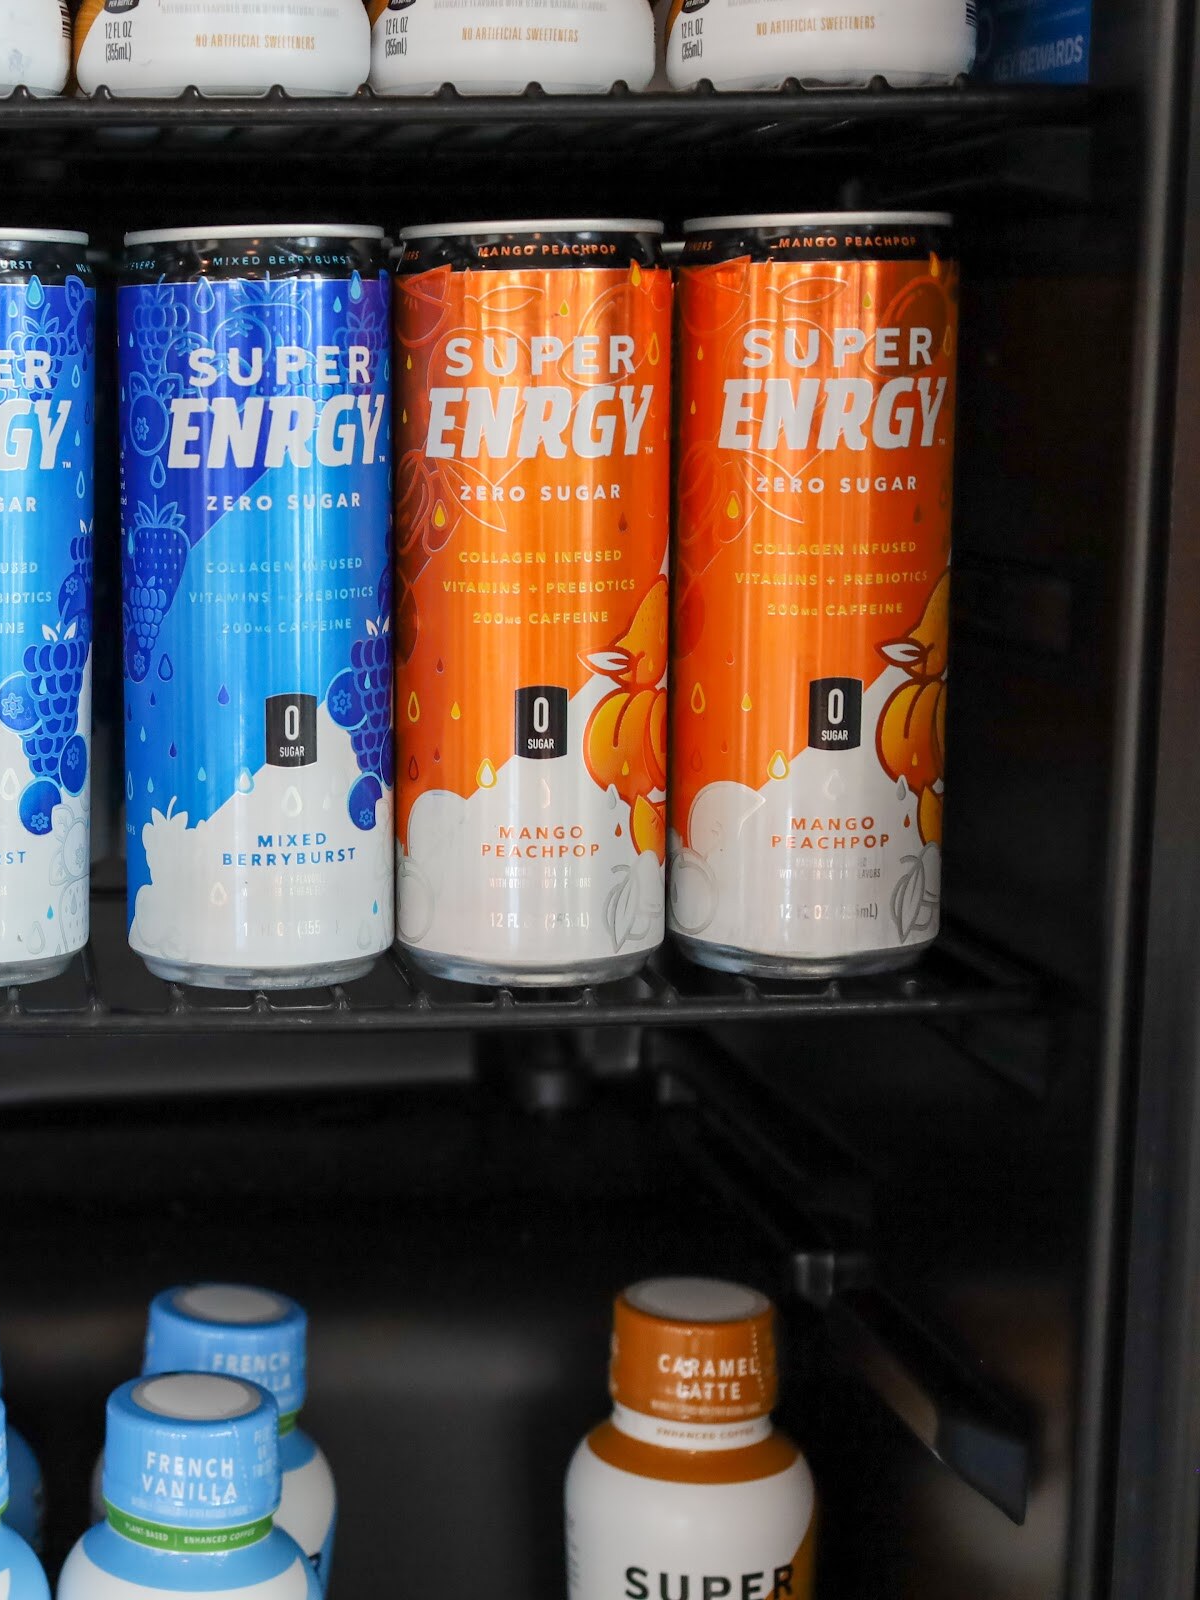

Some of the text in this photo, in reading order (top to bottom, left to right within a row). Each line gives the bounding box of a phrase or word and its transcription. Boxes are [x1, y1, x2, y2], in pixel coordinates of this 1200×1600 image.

[105, 20, 132, 39] 12 FL OZ
[386, 16, 408, 36] 12 FL OZ
[462, 27, 579, 43] NO ARTIFICIAL SWEETENERS
[681, 17, 703, 39] 12 FL OZ
[757, 16, 875, 36] NO ARTIFICIAL SWEETENERS
[195, 34, 315, 50] NO ARTIFICIAL SWEETENERS
[105, 41, 132, 63] (355mL)
[478, 244, 617, 257] MANGO PEACHPOP
[777, 236, 917, 249] MANGO PEACHPOP
[212, 256, 261, 267] MIXED
[445, 335, 635, 377] SUPER
[742, 327, 933, 369] SUPER
[188, 346, 371, 387] SUPER
[425, 385, 654, 459] ENRGY
[717, 376, 948, 451] ENRGY
[167, 394, 385, 469] ENRGY
[460, 484, 620, 501] ZERO SUGAR
[756, 475, 917, 493] ZERO SUGAR
[206, 493, 361, 512] ZERO SUGAR
[458, 549, 622, 564] COLLAGEN INFUSED
[752, 541, 916, 556] COLLAGEN INFUSED
[443, 579, 636, 595] VITAMINS PREBIOTICS
[735, 570, 928, 586] VITAMINS PREBIOTICS
[528, 611, 609, 625] CAFFEINE
[825, 602, 904, 616] CAFFEINE
[533, 696, 549, 733] 0
[827, 688, 845, 724] 0
[283, 704, 300, 741] 0
[527, 737, 554, 750] SUGAR
[821, 729, 848, 741] SUGAR
[279, 745, 305, 758] SUGAR
[790, 816, 874, 831] MANGO
[257, 832, 327, 848] MIXED
[498, 826, 584, 840] MANGO
[771, 834, 890, 849] PEACHPOP
[222, 847, 356, 866] BERRYBURST
[481, 843, 600, 858] PEACHPOP
[213, 1351, 290, 1373] FRENCH
[657, 1353, 758, 1378] CARAMEL
[676, 1381, 741, 1400] LATTE
[146, 1451, 234, 1479] FRENCH
[141, 1473, 237, 1502] VANILLA
[184, 1535, 228, 1545] ENHANCED
[624, 1563, 795, 1600] SUPER
